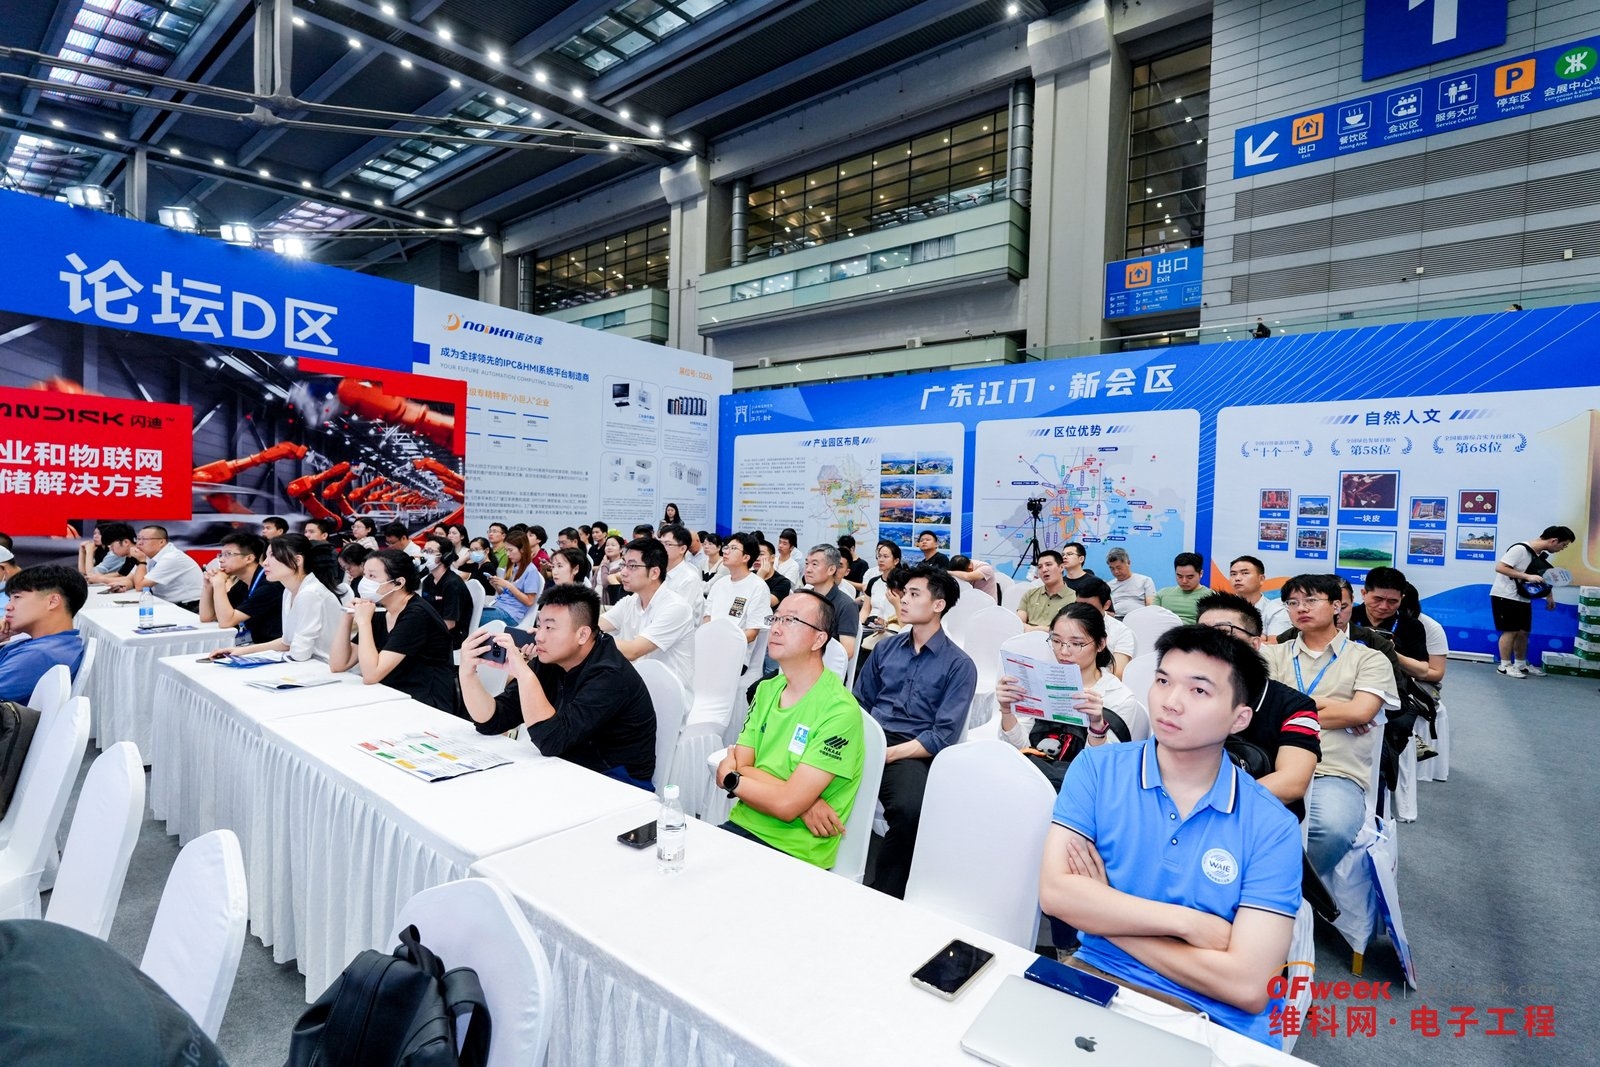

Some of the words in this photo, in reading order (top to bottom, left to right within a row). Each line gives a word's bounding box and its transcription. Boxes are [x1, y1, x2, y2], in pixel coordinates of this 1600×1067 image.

[1408, 0, 1457, 45] 1
[1496, 92, 1531, 108] 停车区
[1435, 104, 1479, 123] 服务大厅
[1501, 104, 1525, 113] Parking
[1388, 119, 1419, 133] 会议区
[1436, 119, 1457, 128] Service
[1457, 115, 1477, 123] Center
[1339, 131, 1368, 145] 餐饮区
[1384, 130, 1411, 140] Conference
[1298, 144, 1316, 154] 出口
[1339, 143, 1355, 151] Dining
[1157, 257, 1188, 274] 出口
[59, 253, 338, 356] 论坛D区
[441, 347, 590, 383] 成为全球领先的IPC&HMI系统平台制造商
[440, 363, 456, 371] YOUR
[457, 365, 479, 375] FUTURE
[481, 370, 516, 380] AUTOMATION
[517, 375, 546, 386] COMPUTING
[547, 382, 574, 391] SOLUTIONS
[920, 364, 1177, 411] 广东江门·新会区
[131, 414, 163, 429] 闪迪
[1366, 408, 1441, 426] 自然人文
[1054, 425, 1101, 438] 区位优势
[813, 436, 860, 448] 产业园区布局
[1456, 441, 1502, 454] 第68位
[0, 440, 162, 472] 业和物联网
[1350, 444, 1392, 456] 第58位
[0, 469, 163, 498] 储解决方案
[1353, 514, 1381, 523] 一块皮
[1209, 860, 1231, 873] WAIE
